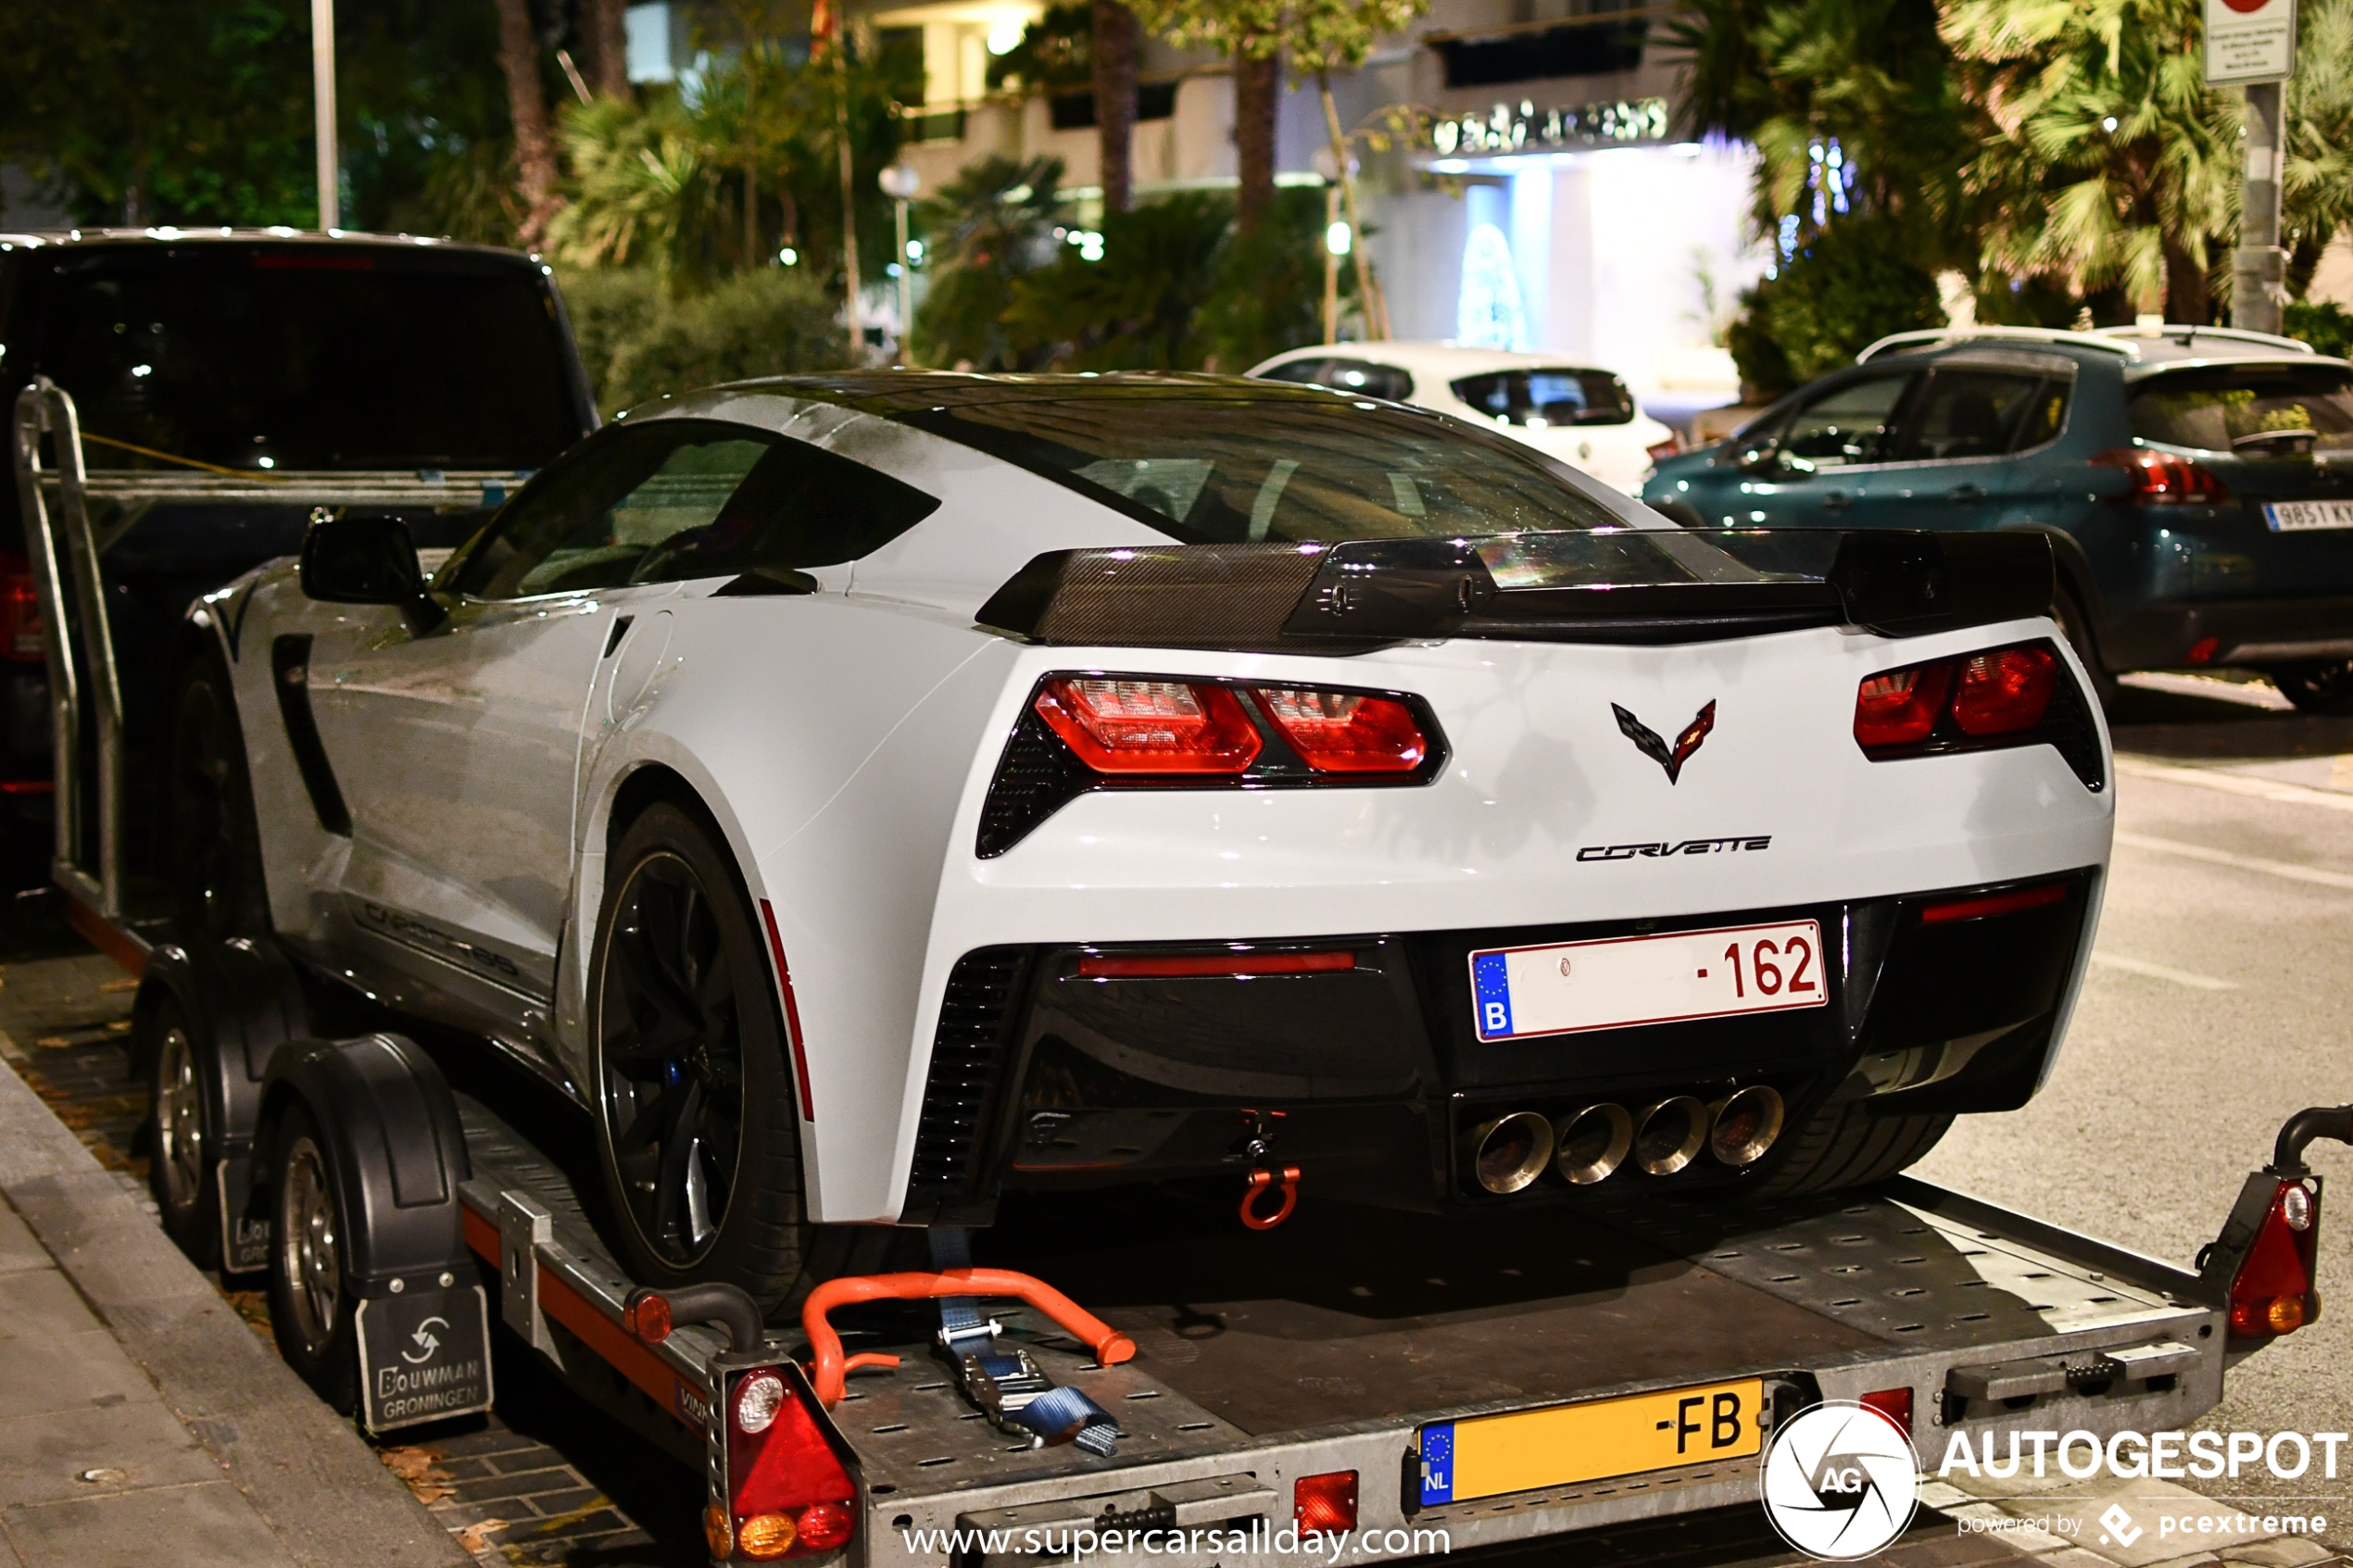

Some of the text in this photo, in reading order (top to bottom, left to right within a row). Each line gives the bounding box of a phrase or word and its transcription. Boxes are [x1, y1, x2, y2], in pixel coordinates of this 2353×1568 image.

[2280, 503, 2327, 525] 9851
[1576, 835, 1772, 861] CORVETTE
[1485, 1002, 1507, 1030] B
[384, 1386, 479, 1419] GRONINGEN
[1425, 1473, 1449, 1492] NL
